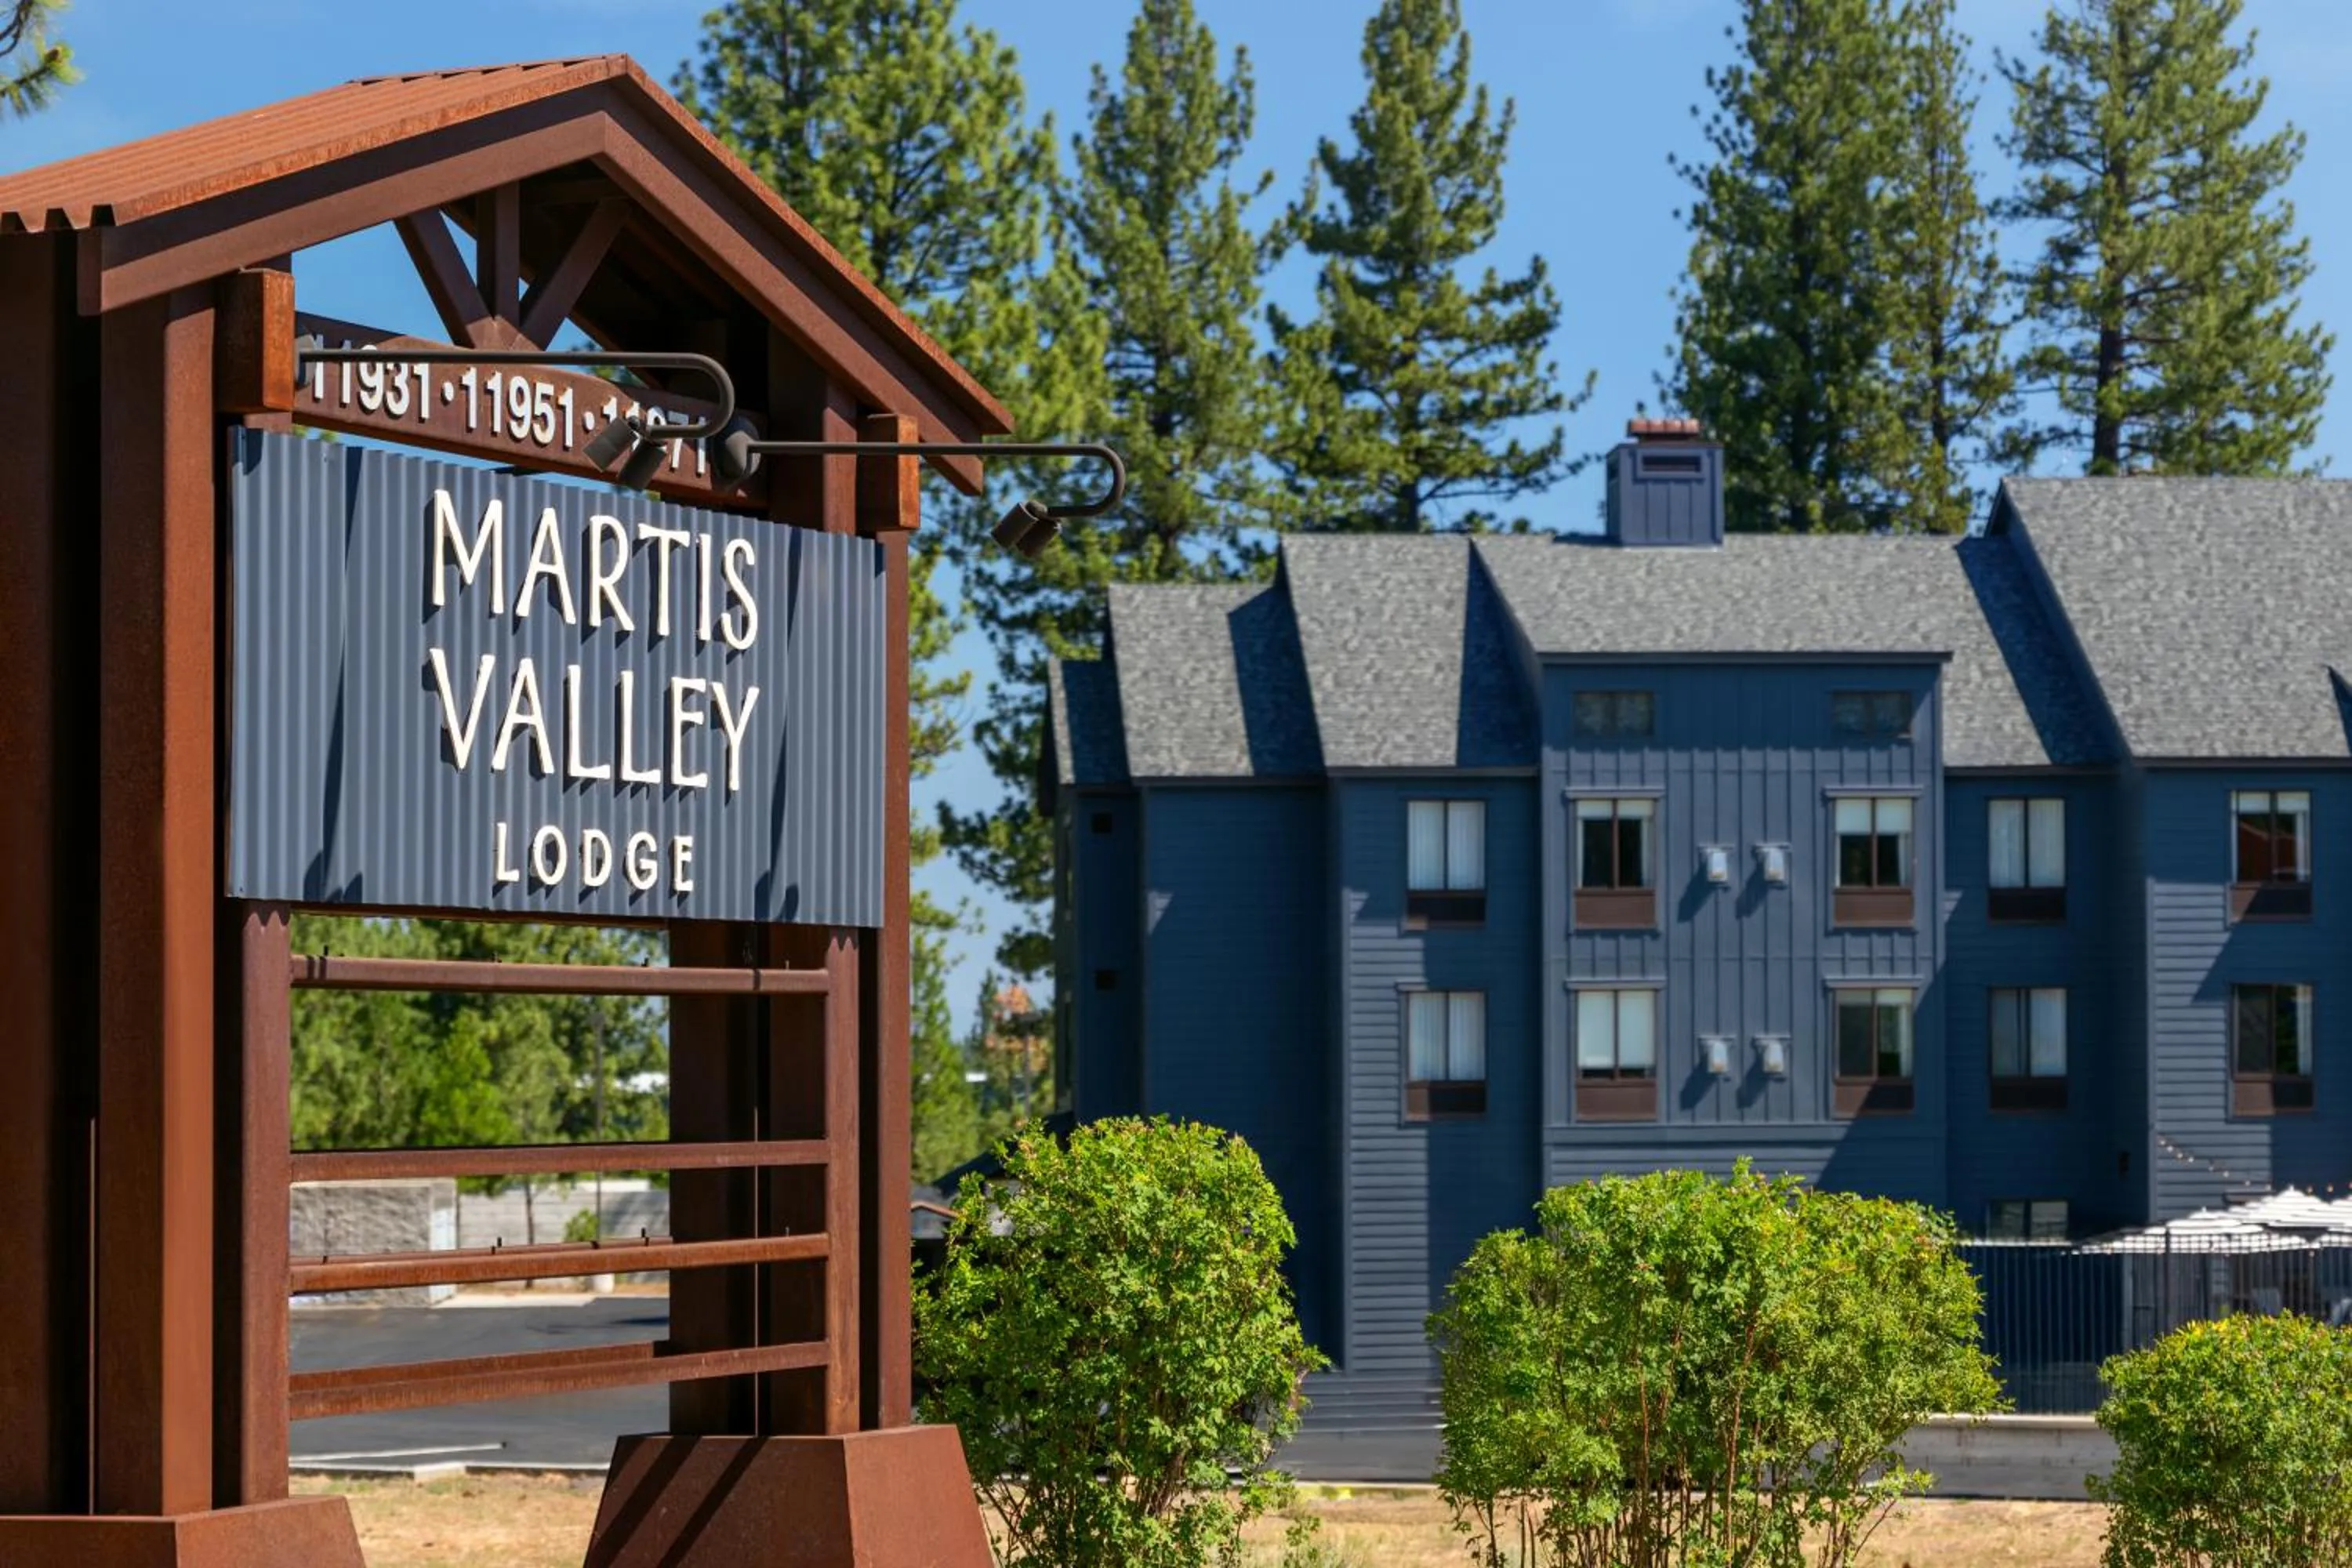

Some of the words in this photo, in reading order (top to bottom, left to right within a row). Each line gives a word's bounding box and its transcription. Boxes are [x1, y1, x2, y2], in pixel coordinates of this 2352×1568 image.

[314, 334, 430, 419] 11931
[461, 366, 575, 448] 11951
[432, 489, 759, 651] MARTIS
[429, 648, 760, 791] VALLEY
[494, 822, 694, 892] LODGE
